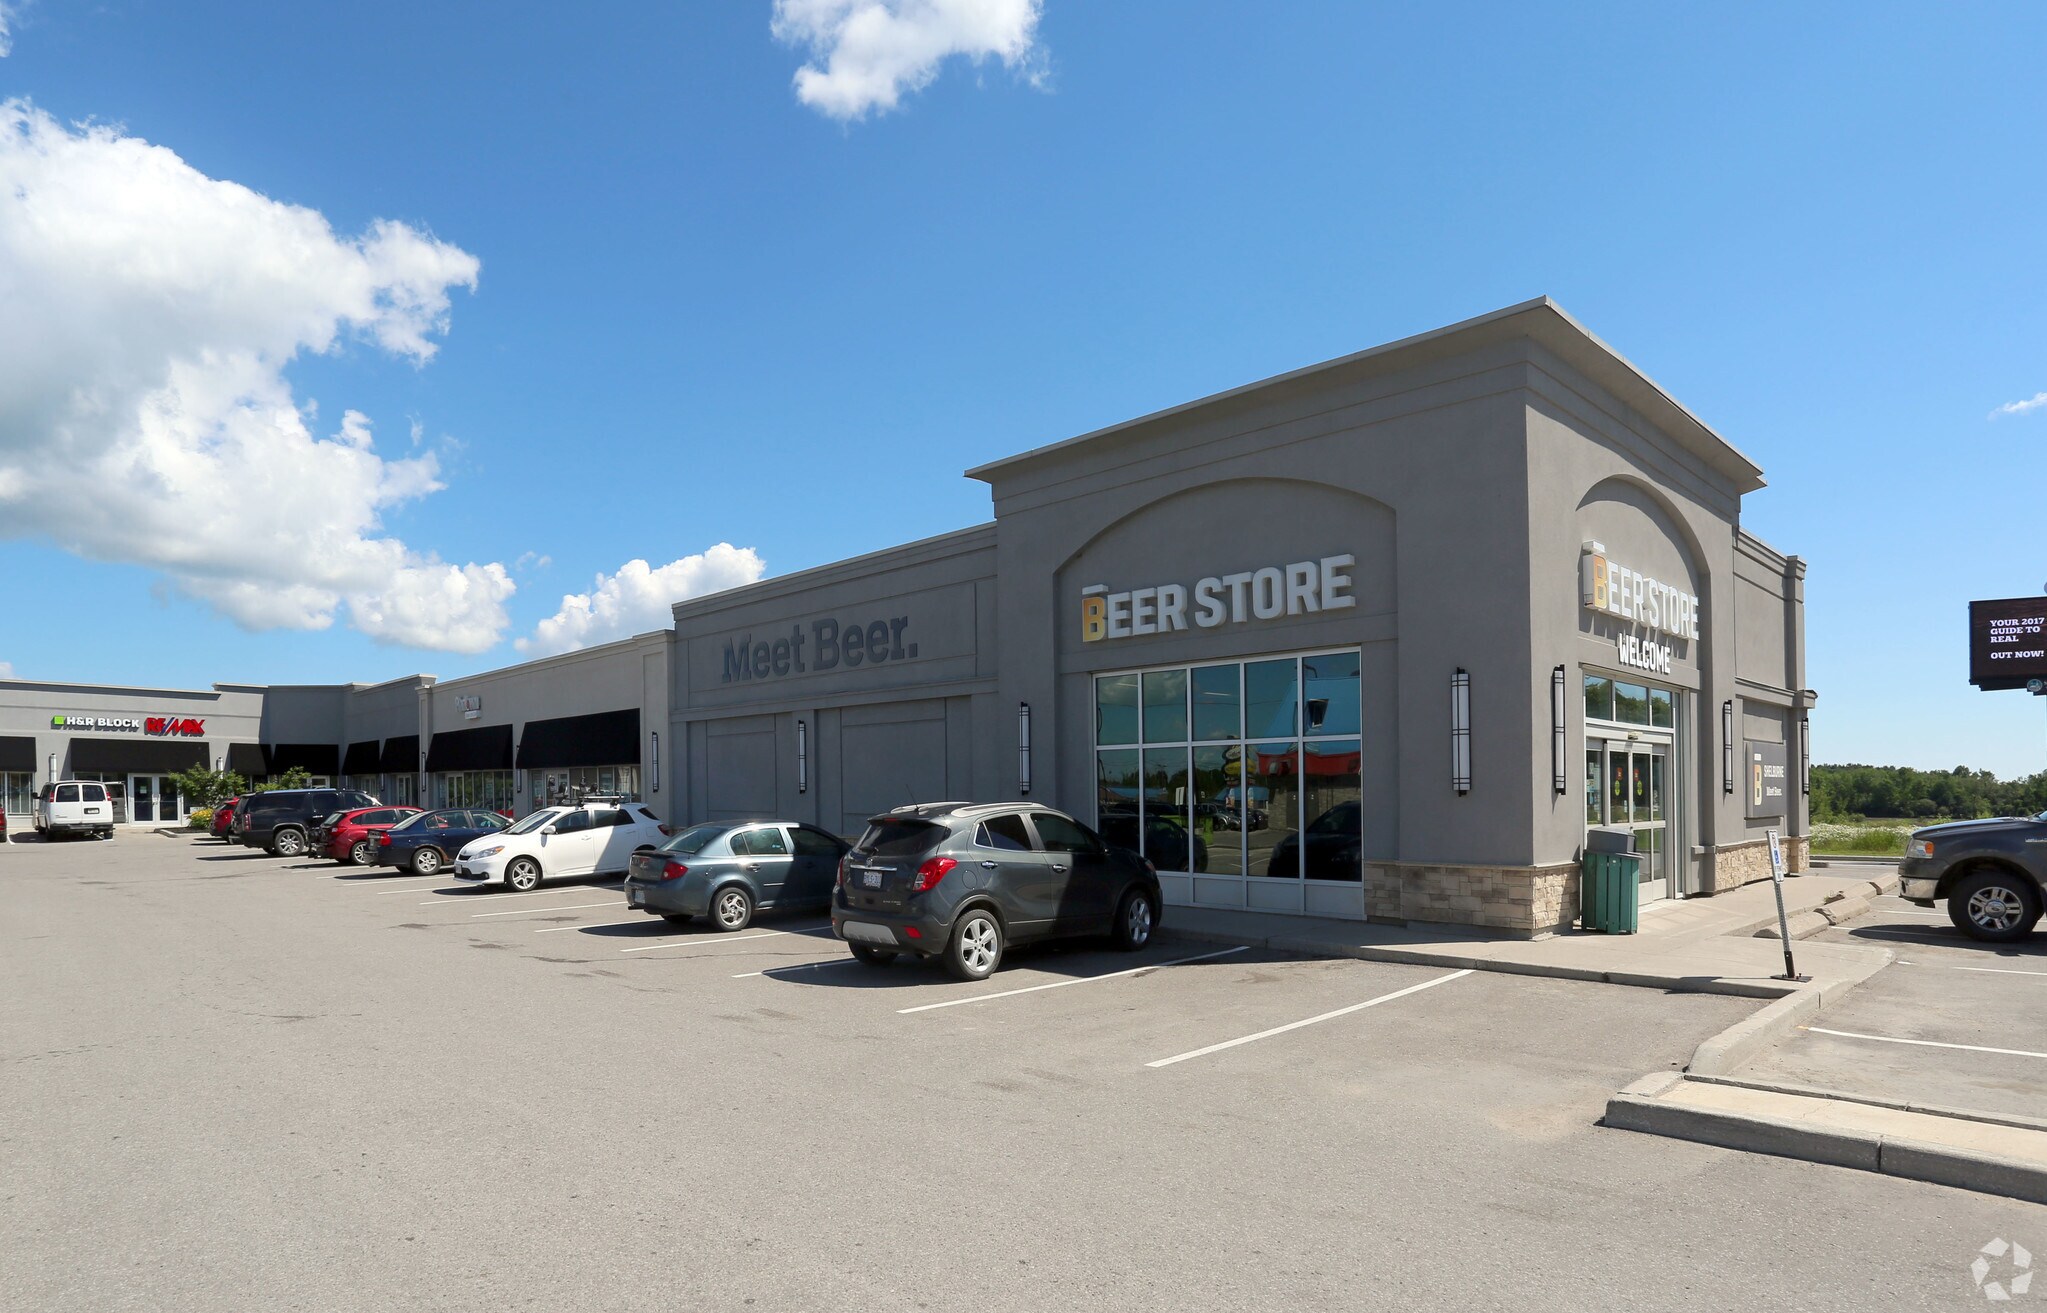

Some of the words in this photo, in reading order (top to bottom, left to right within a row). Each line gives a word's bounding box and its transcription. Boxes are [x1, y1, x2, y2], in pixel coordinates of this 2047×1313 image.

[1583, 541, 1644, 623] BEER
[1646, 577, 1699, 641] STORE
[1082, 584, 1188, 642] BEER
[1195, 554, 1356, 628] STORE
[1990, 619, 2019, 627] YOUR
[2021, 617, 2045, 625] 2017
[1990, 627, 2023, 635] GUIDE
[1990, 635, 2019, 643] REAL
[721, 624, 805, 684] Meet
[812, 616, 918, 671] Beer.
[1619, 632, 1671, 674] WELCOME
[1990, 651, 2012, 659] OUT
[2014, 650, 2044, 658] NOW!
[66, 716, 94, 726] H&R
[97, 718, 140, 728] BLOCK
